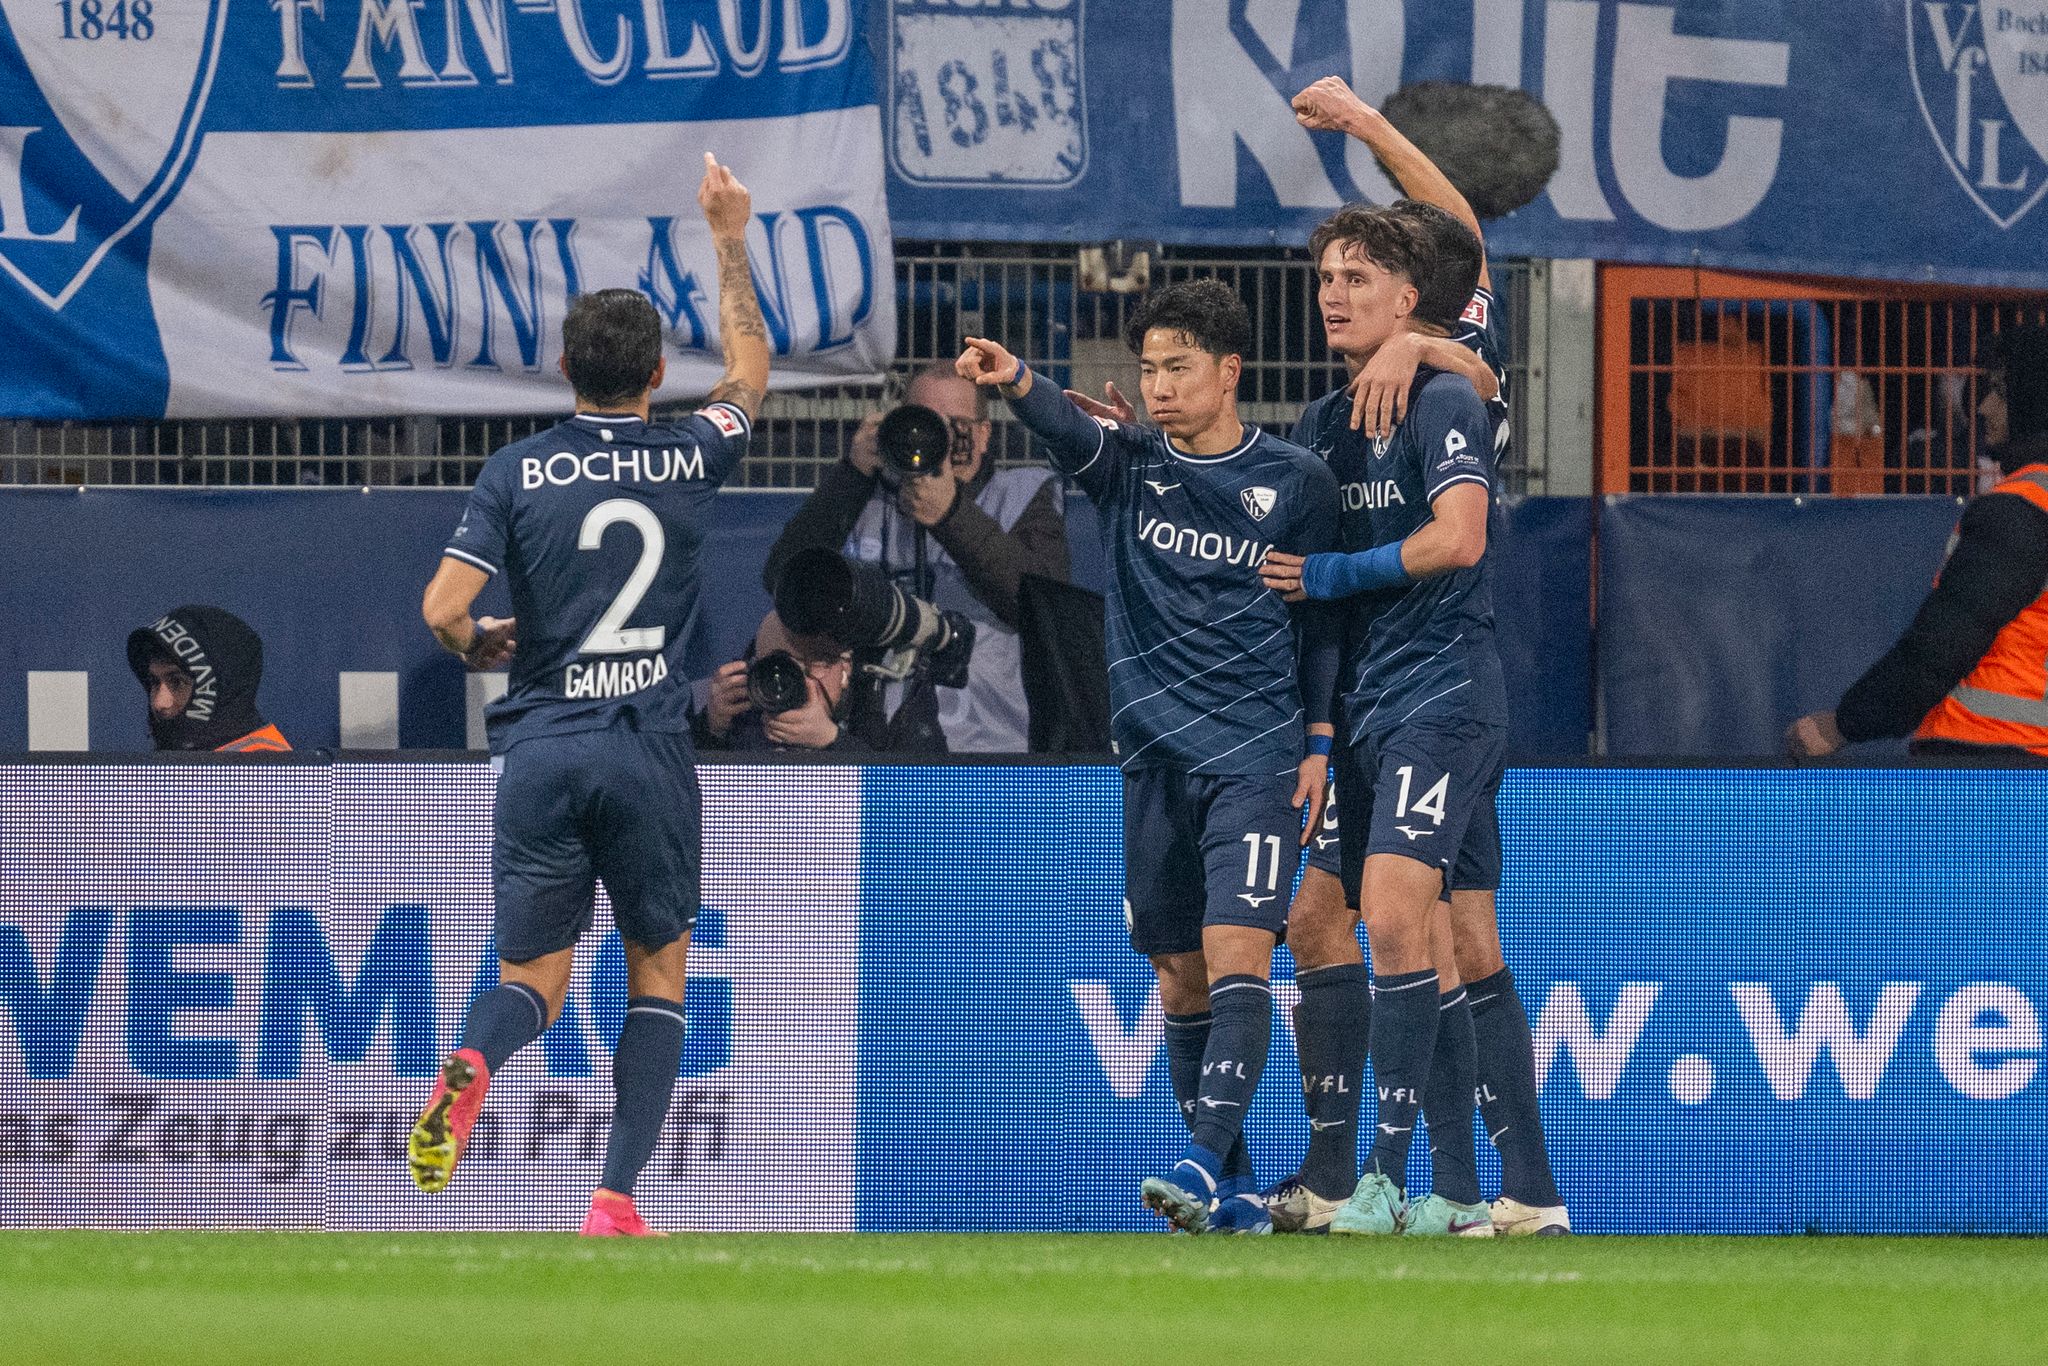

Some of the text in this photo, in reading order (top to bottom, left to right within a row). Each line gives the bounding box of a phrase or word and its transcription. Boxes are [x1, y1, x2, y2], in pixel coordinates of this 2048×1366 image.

[55, 0, 154, 41] 1848
[521, 445, 705, 490] BOCHUM
[1340, 480, 1406, 512] OVIA
[578, 498, 666, 653] 2
[565, 653, 668, 699] GAMBOA
[1395, 765, 1451, 826] 14
[1242, 832, 1282, 891] 11
[1069, 979, 2044, 1104] ww.we
[1202, 1060, 1246, 1080] VfL
[1302, 1074, 1349, 1094] VfL
[1378, 1086, 1417, 1105] VfL
[1474, 1083, 1498, 1107] fL
[102, 1094, 305, 1185] Zeug
[530, 1090, 730, 1177] Prfi
